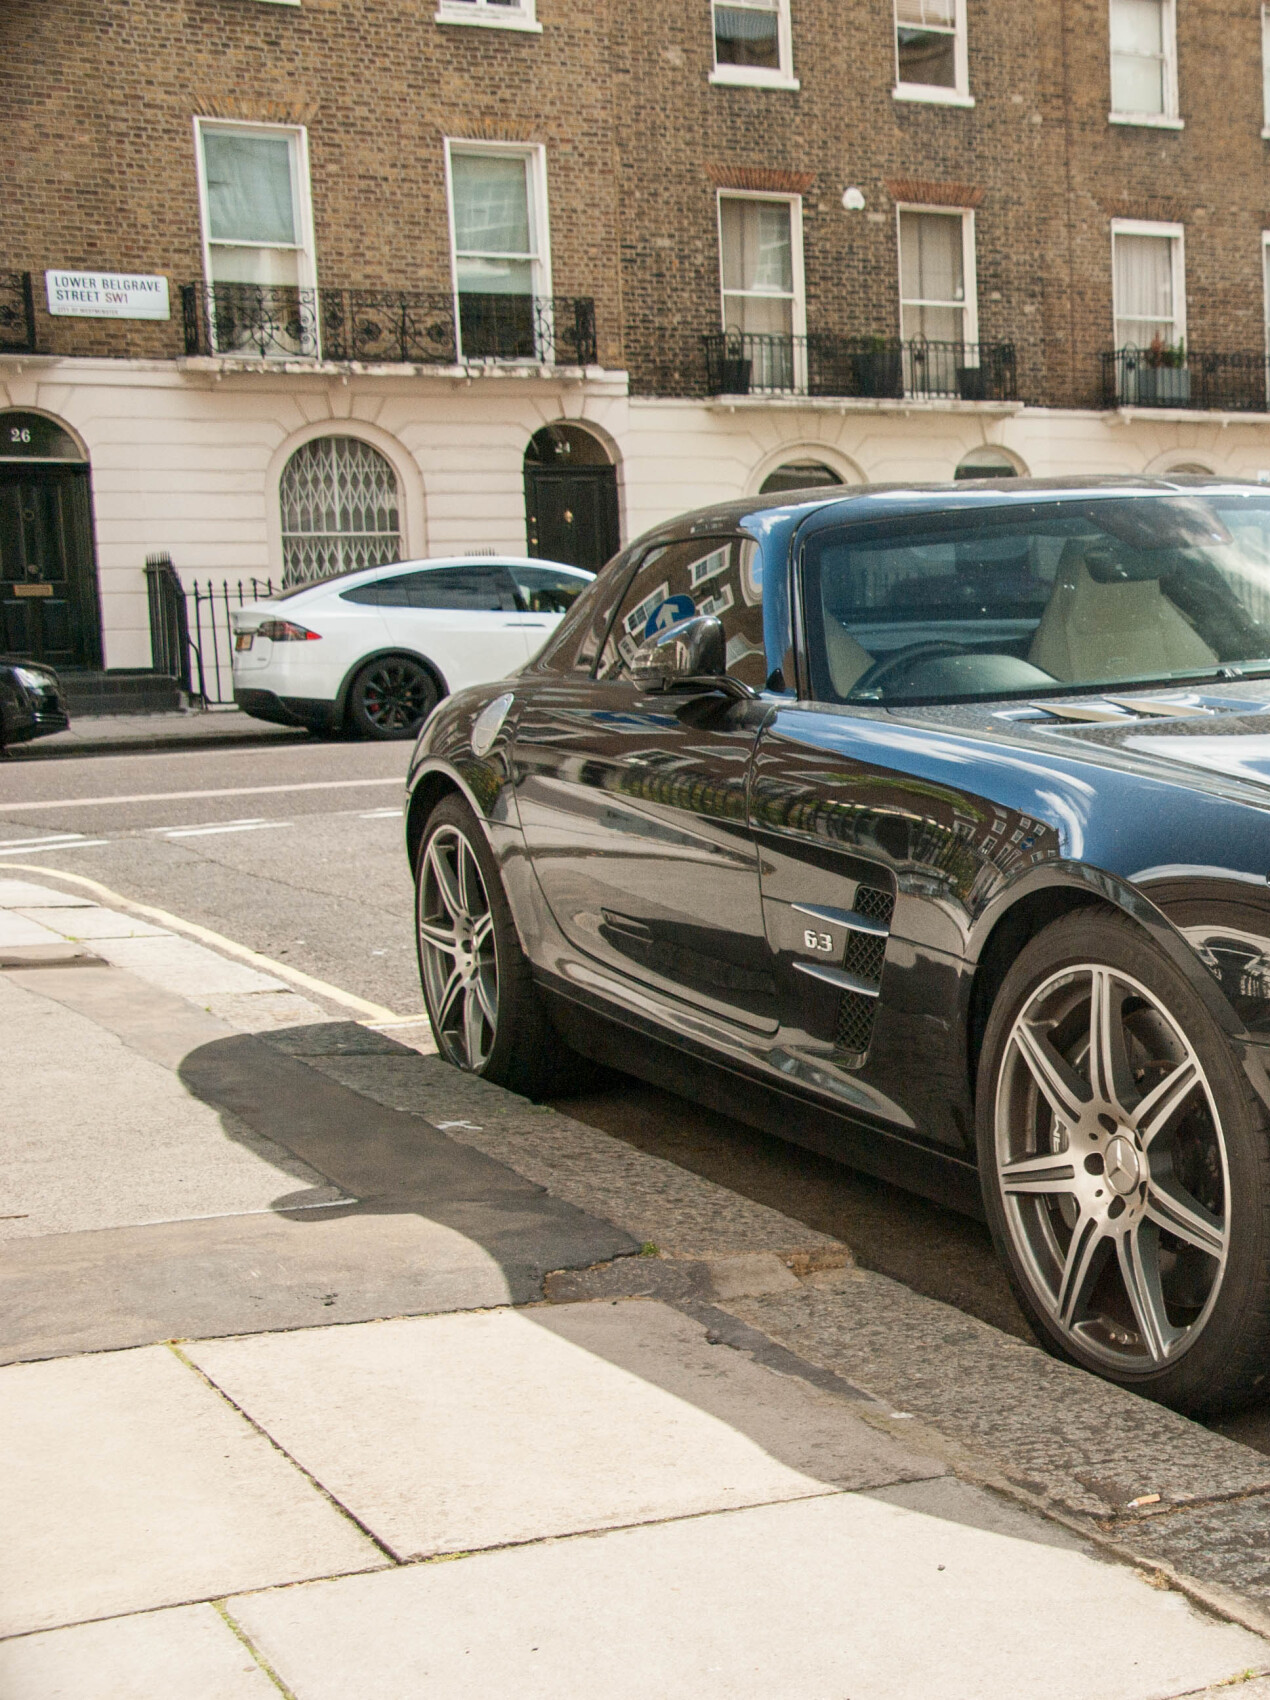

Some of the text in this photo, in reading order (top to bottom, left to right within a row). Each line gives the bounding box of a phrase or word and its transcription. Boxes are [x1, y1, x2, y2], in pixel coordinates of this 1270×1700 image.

[54, 275, 161, 292] LOWER BELGRAVE
[56, 289, 129, 304] STREET SW1
[10, 427, 31, 443] 26
[804, 930, 832, 952] 6.3
